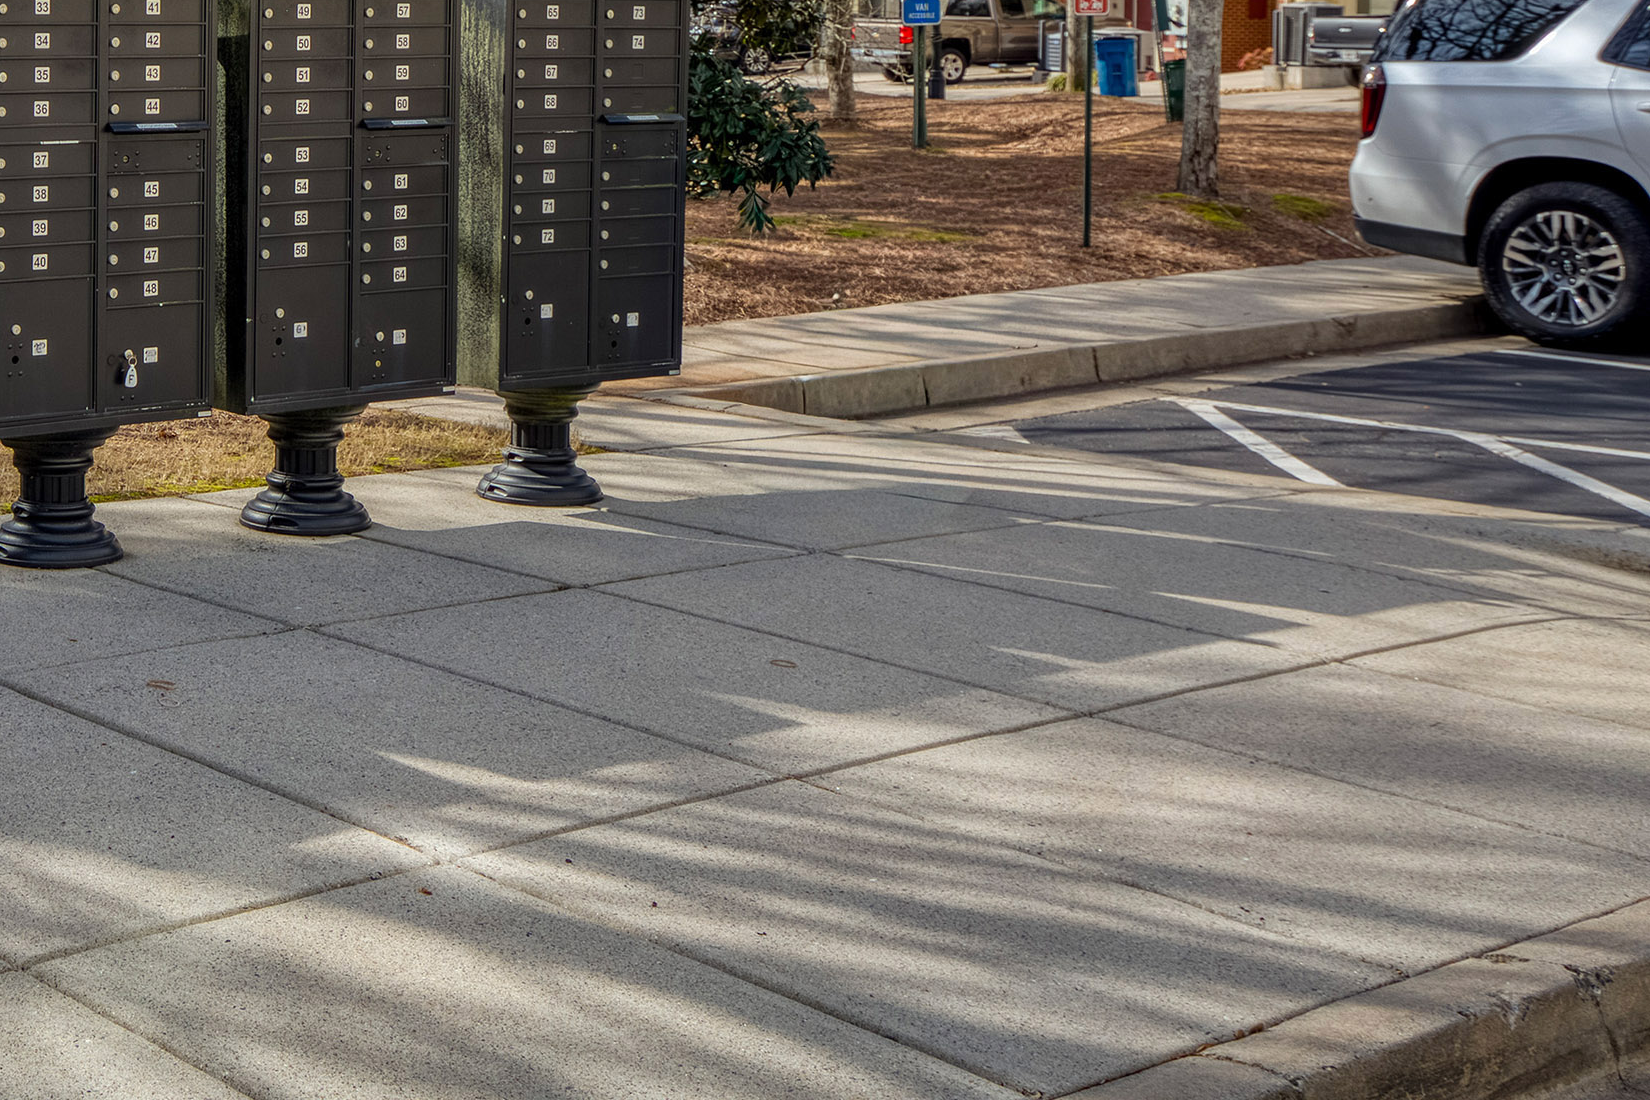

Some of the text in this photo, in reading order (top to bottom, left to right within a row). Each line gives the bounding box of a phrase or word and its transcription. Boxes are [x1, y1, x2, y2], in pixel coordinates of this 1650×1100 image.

[36, 1, 49, 13] 33
[148, 2, 159, 13] 41
[298, 6, 310, 17] 49
[398, 5, 409, 16] 57
[548, 7, 558, 18] 65
[915, 3, 929, 11] VAN
[634, 8, 644, 18] 73
[36, 35, 49, 46] 34
[147, 34, 159, 46] 42
[298, 38, 310, 49] 50
[397, 36, 408, 47] 58
[547, 37, 557, 48] 66
[634, 37, 643, 47] 74
[36, 69, 49, 81] 35
[146, 67, 159, 79] 43
[298, 70, 308, 81] 51
[397, 67, 408, 78] 59
[546, 67, 556, 77] 67
[146, 101, 158, 112] 44
[297, 102, 309, 113] 52
[397, 98, 408, 109] 60
[545, 97, 556, 107] 68
[35, 103, 48, 115] 36
[545, 141, 555, 151] 69
[35, 154, 47, 166] 37
[297, 149, 308, 161] 53
[396, 176, 406, 187] 61
[544, 171, 554, 182] 70
[145, 184, 158, 195] 45
[296, 181, 307, 192] 54
[34, 188, 47, 200] 38
[544, 201, 553, 212] 71
[395, 207, 406, 218] 62
[145, 217, 157, 228] 46
[295, 213, 307, 224] 55
[34, 222, 47, 234] 39
[543, 231, 553, 242] 72
[395, 238, 406, 249] 63
[145, 250, 157, 261] 47
[295, 244, 307, 256] 56
[33, 256, 46, 268] 40
[394, 269, 405, 281] 64
[145, 282, 157, 294] 48
